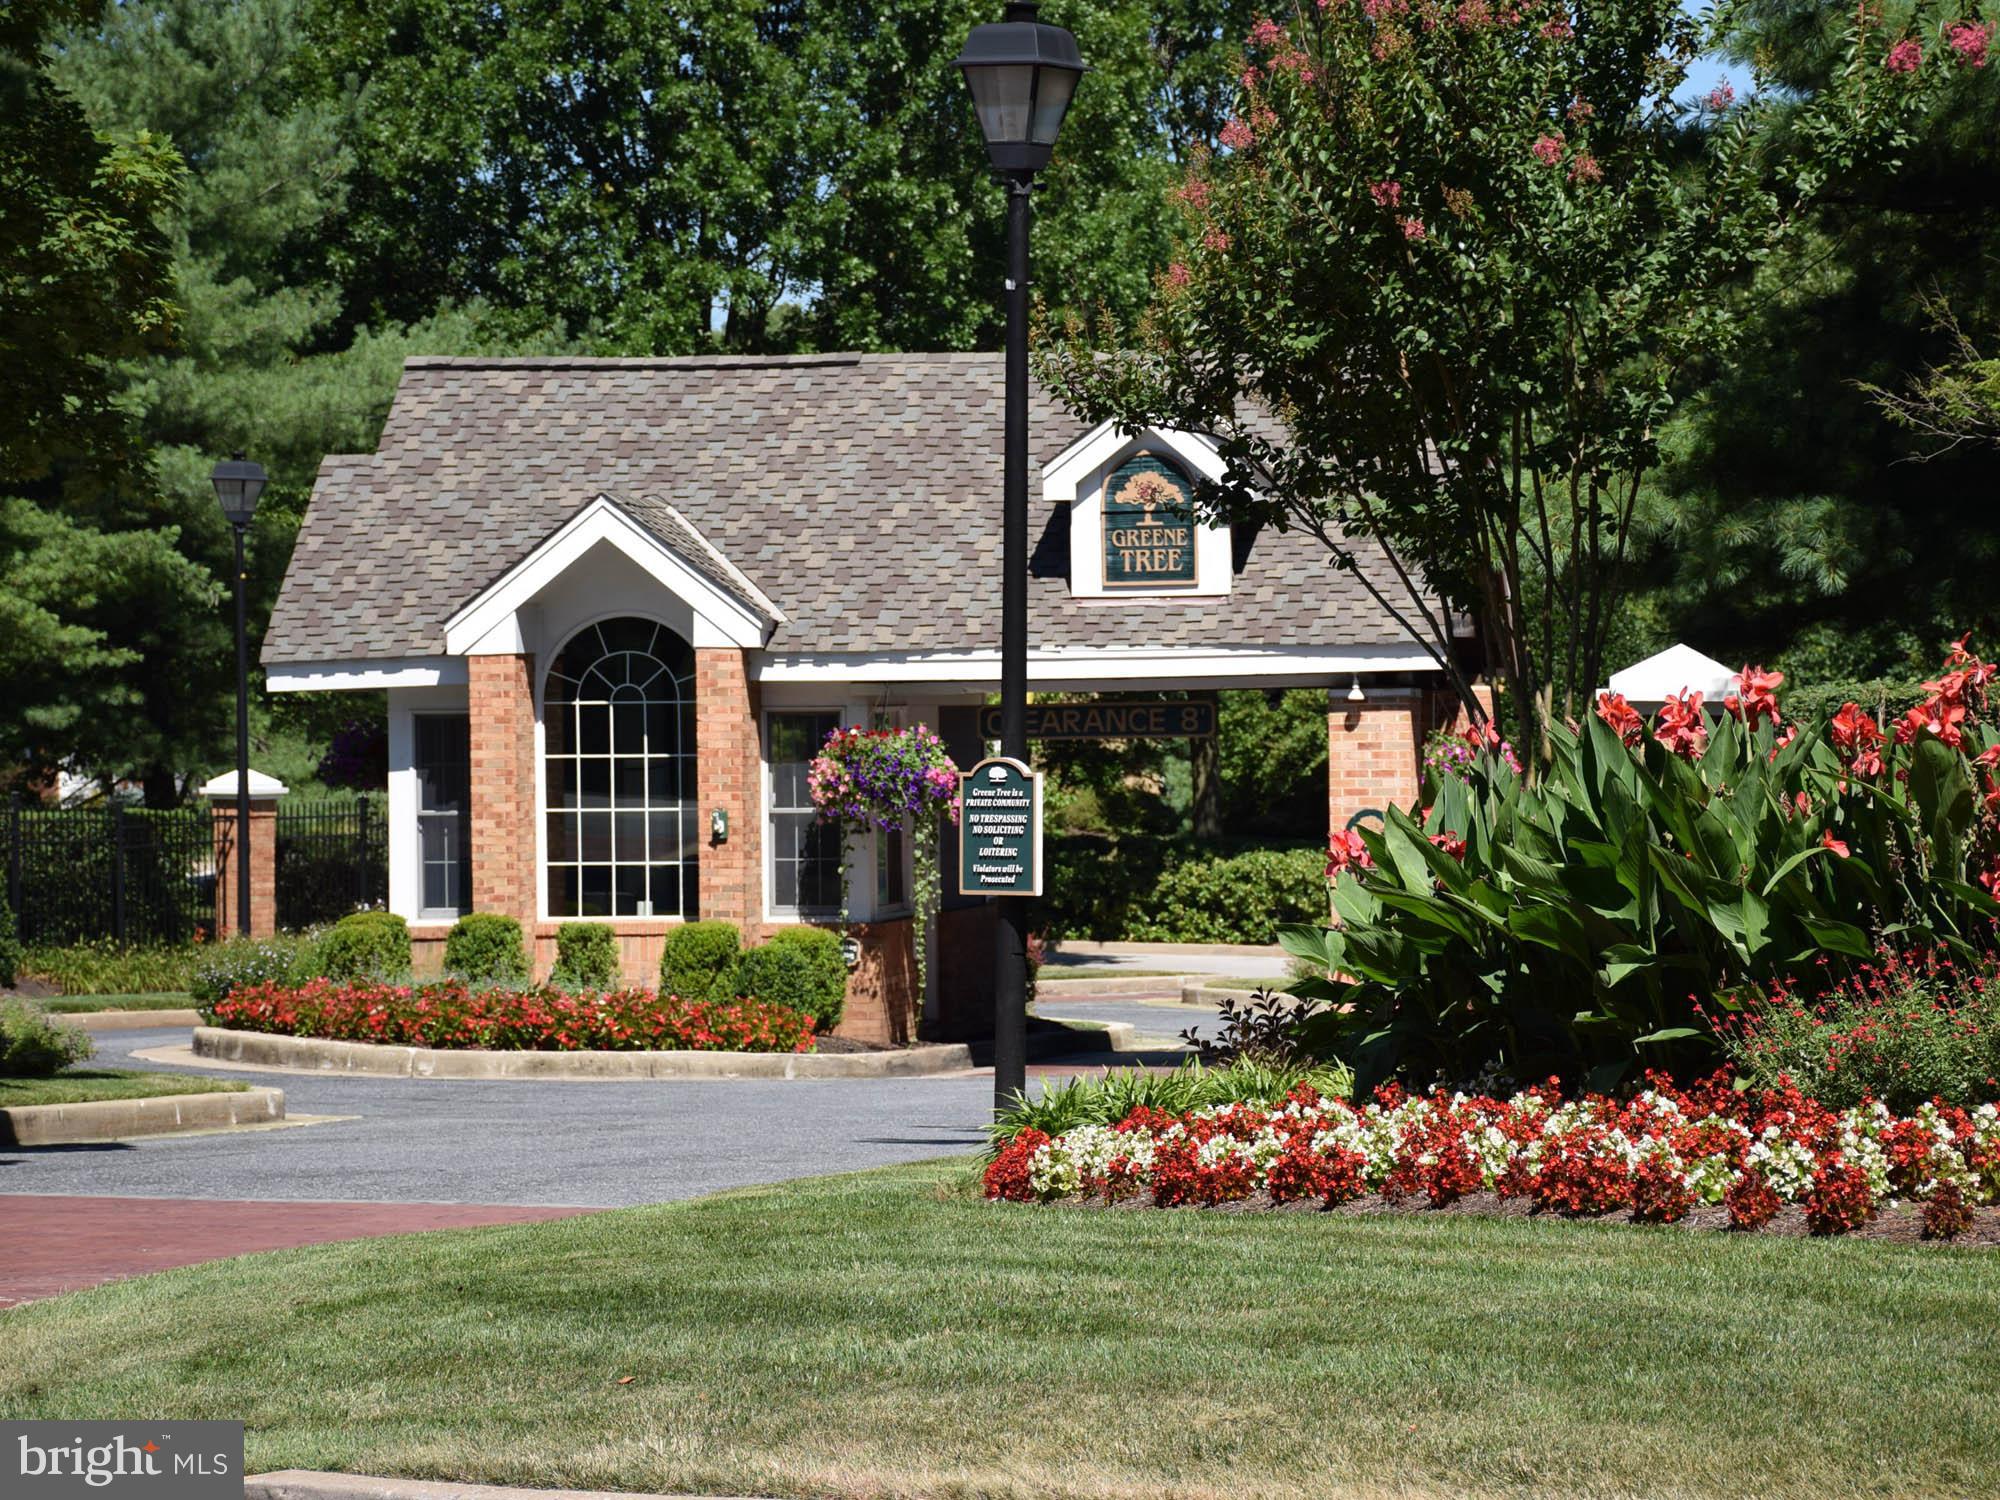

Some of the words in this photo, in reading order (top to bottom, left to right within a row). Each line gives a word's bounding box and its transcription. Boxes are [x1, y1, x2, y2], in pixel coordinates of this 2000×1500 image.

[1111, 527, 1188, 548] GREENE
[1119, 548, 1183, 573] TREE
[986, 707, 1165, 735] CEARANCE
[972, 788, 995, 797] Greene
[996, 788, 1011, 797] Tree
[966, 799, 992, 807] PRIVATE
[993, 799, 1030, 807] COMMUNITY
[969, 814, 979, 823] NO
[980, 814, 1028, 823] TRESPASSING
[972, 825, 983, 834] NO
[984, 825, 1025, 834] SOLICITING
[993, 837, 1003, 845] OR
[979, 848, 1018, 856] LOITERING
[973, 864, 1001, 873] Violators
[1002, 864, 1014, 873] will
[1015, 864, 1024, 873] be
[980, 875, 1016, 883] Prosecuted
